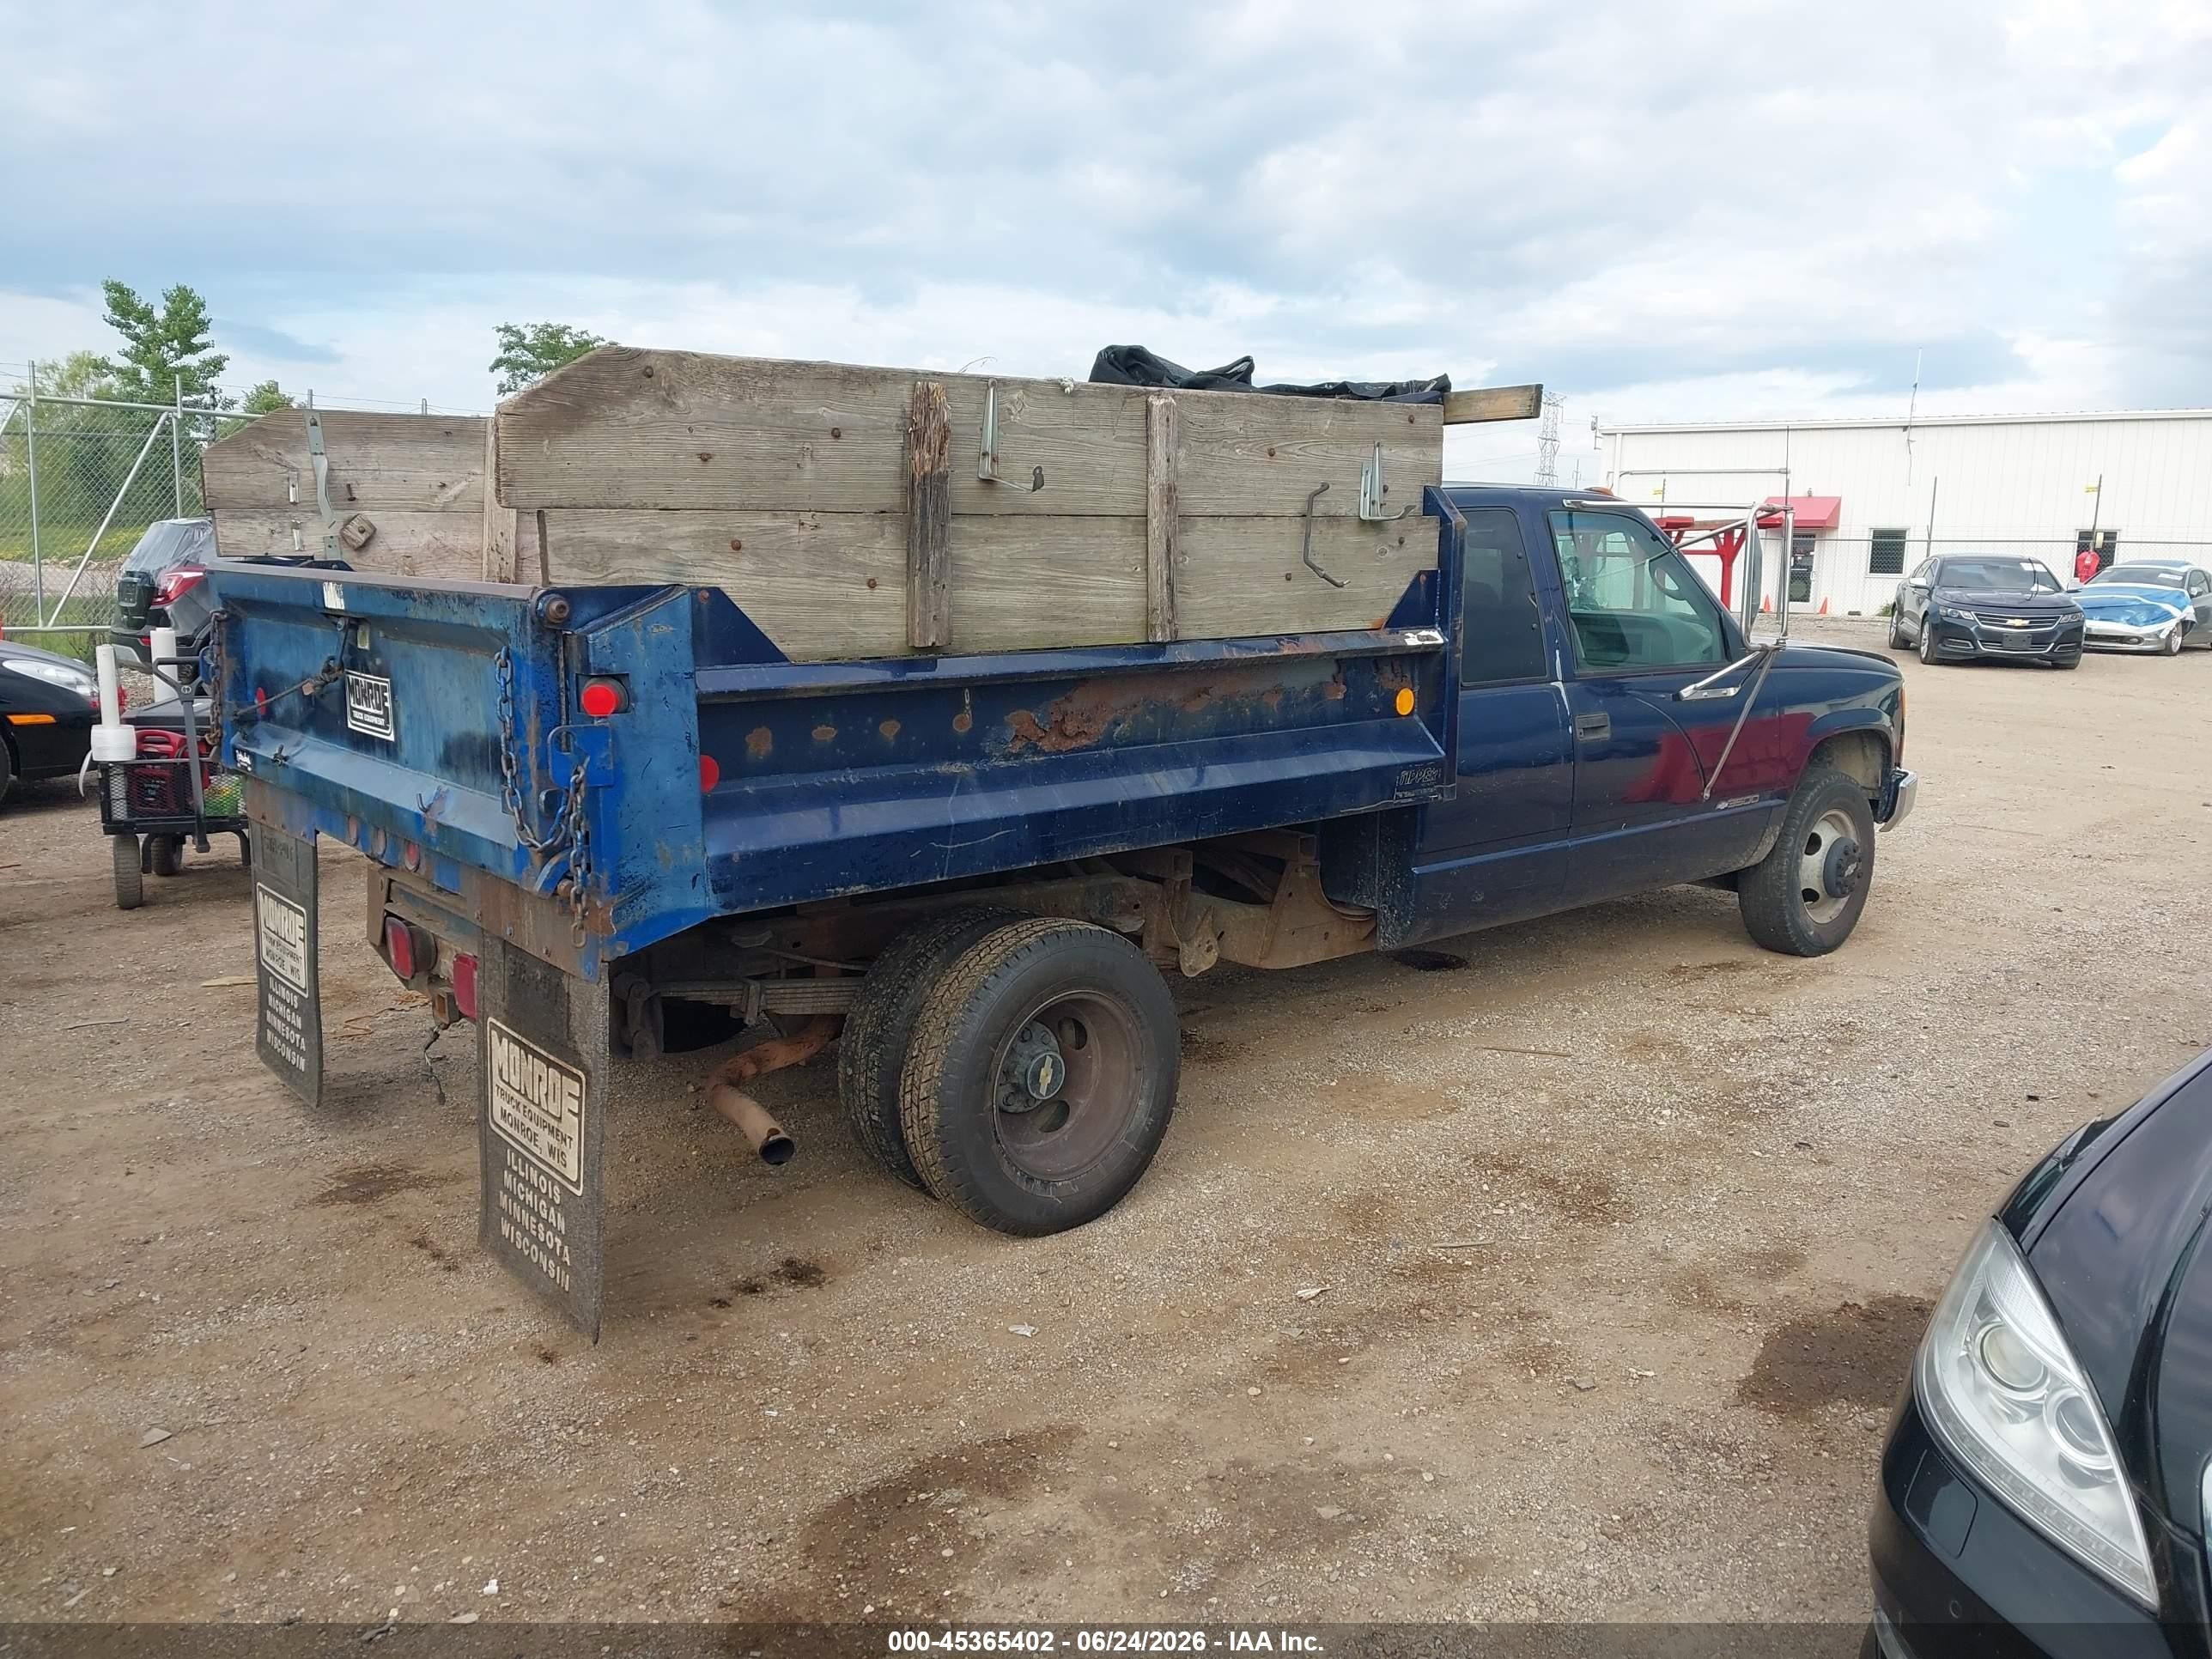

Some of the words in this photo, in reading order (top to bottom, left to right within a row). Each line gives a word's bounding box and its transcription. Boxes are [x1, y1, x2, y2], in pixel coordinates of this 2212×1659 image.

[347, 676, 388, 712] MONROE
[259, 890, 304, 947] MONROE
[269, 975, 298, 1009] ILLINOIS
[290, 964, 301, 981] WIS
[266, 1009, 306, 1052] MINNESOTA
[268, 993, 301, 1030] MICHIGAN
[266, 1029, 306, 1073] WISCONSIN
[491, 1030, 580, 1121] MONROE
[495, 1083, 521, 1115] TRUCK
[522, 1103, 574, 1150] EQUIPMENT
[500, 1105, 543, 1156] MONROE,
[547, 1140, 568, 1170] WIS
[503, 1170, 566, 1236] MICHIGAN
[507, 1148, 561, 1205] ILLINOIS
[499, 1190, 571, 1267] MINNESOTA
[501, 1216, 570, 1293] WISCONSIN
